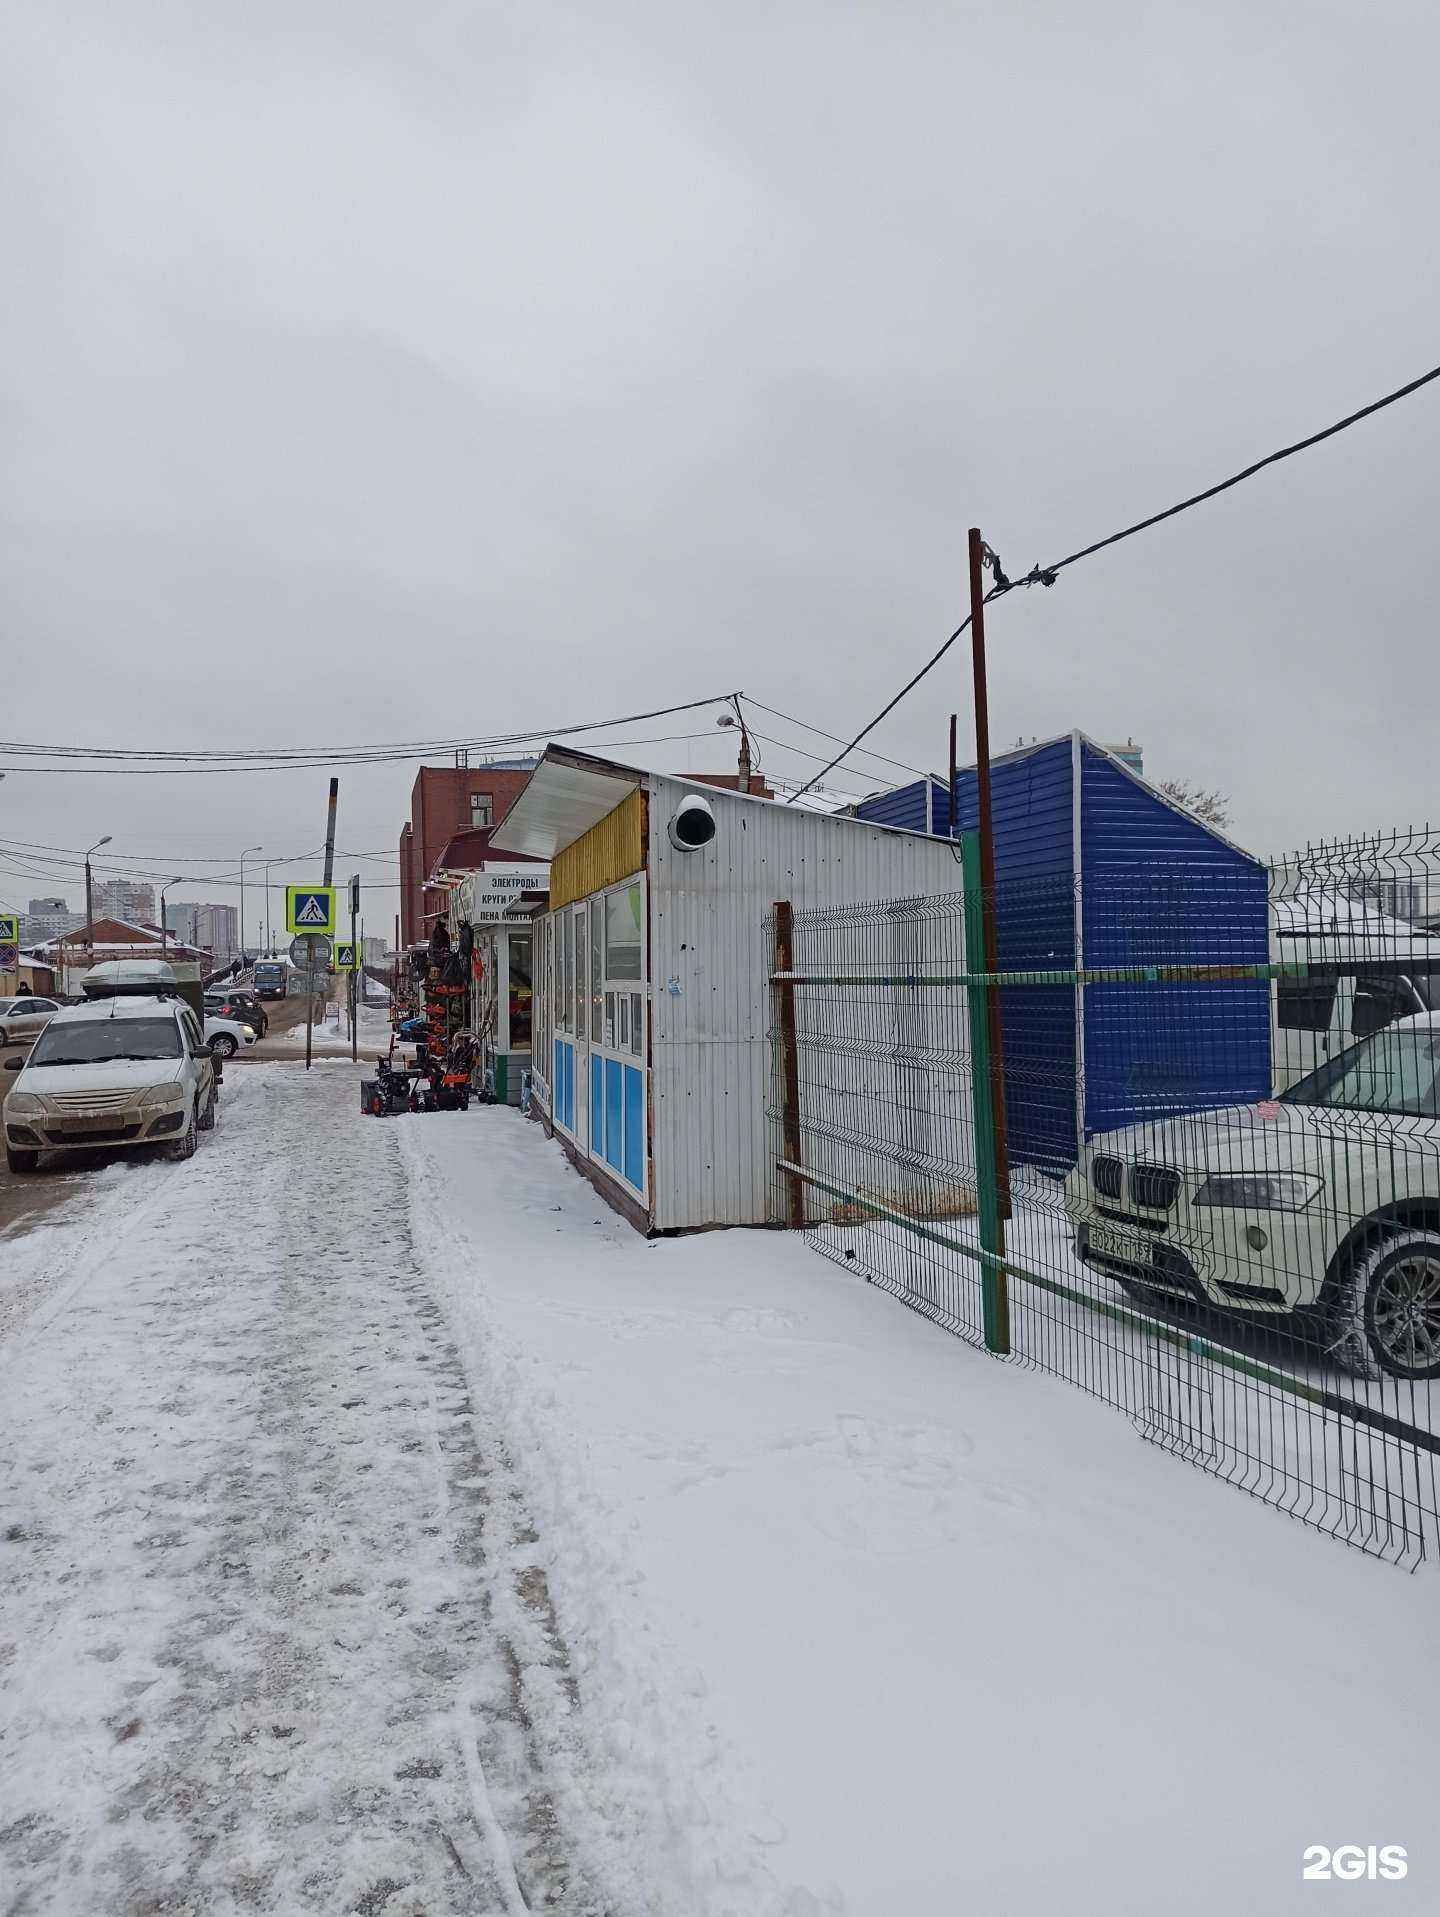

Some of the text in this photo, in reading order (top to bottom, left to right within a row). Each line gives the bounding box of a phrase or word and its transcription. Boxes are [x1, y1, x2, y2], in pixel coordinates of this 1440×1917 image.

[492, 878, 539, 889] ЭЛЕКТРОДЫ
[482, 894, 506, 904] КРУГИ
[480, 911, 500, 921] ПЕНА
